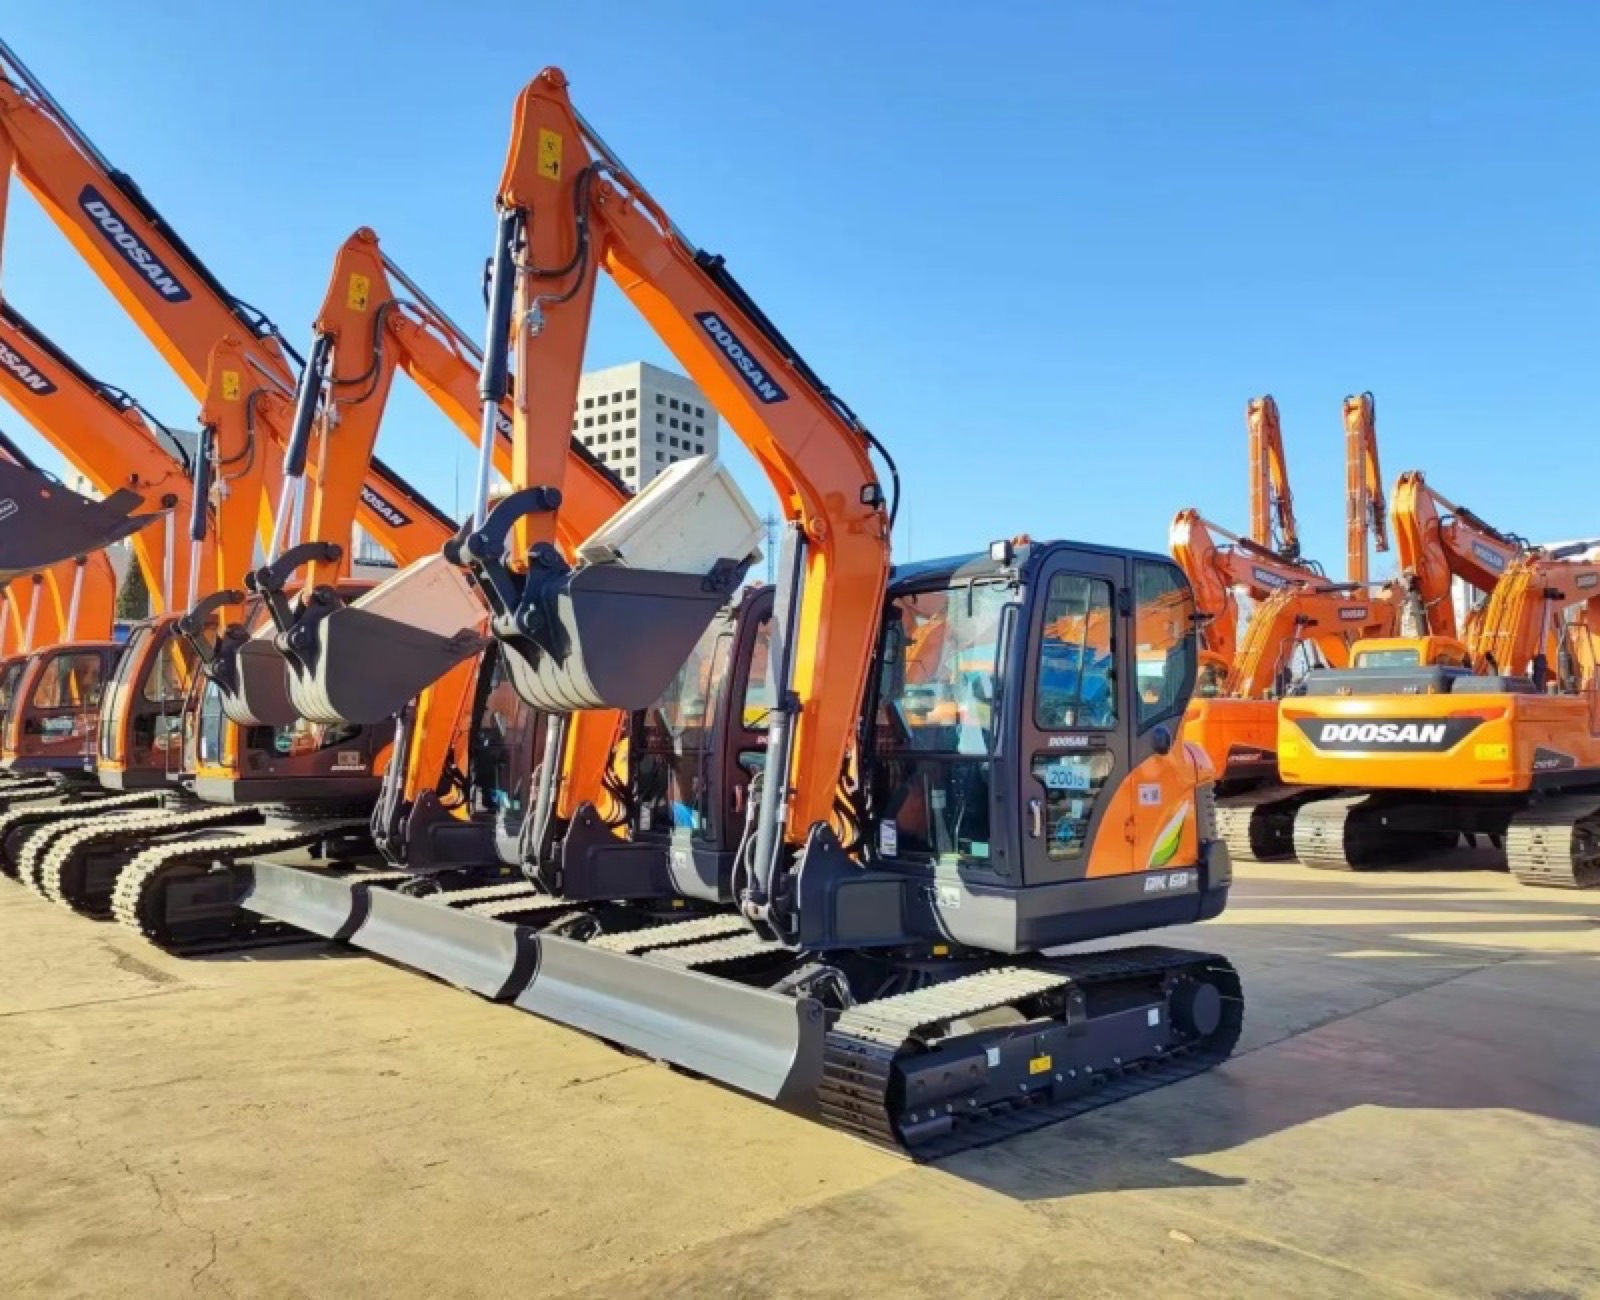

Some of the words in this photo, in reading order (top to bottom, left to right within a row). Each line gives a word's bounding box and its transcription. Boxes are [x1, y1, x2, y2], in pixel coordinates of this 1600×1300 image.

[84, 201, 181, 295] DOOSAN
[703, 316, 777, 400] DOOSAN
[1048, 735, 1089, 747] DOOSAN
[1321, 723, 1447, 743] DOOSAN
